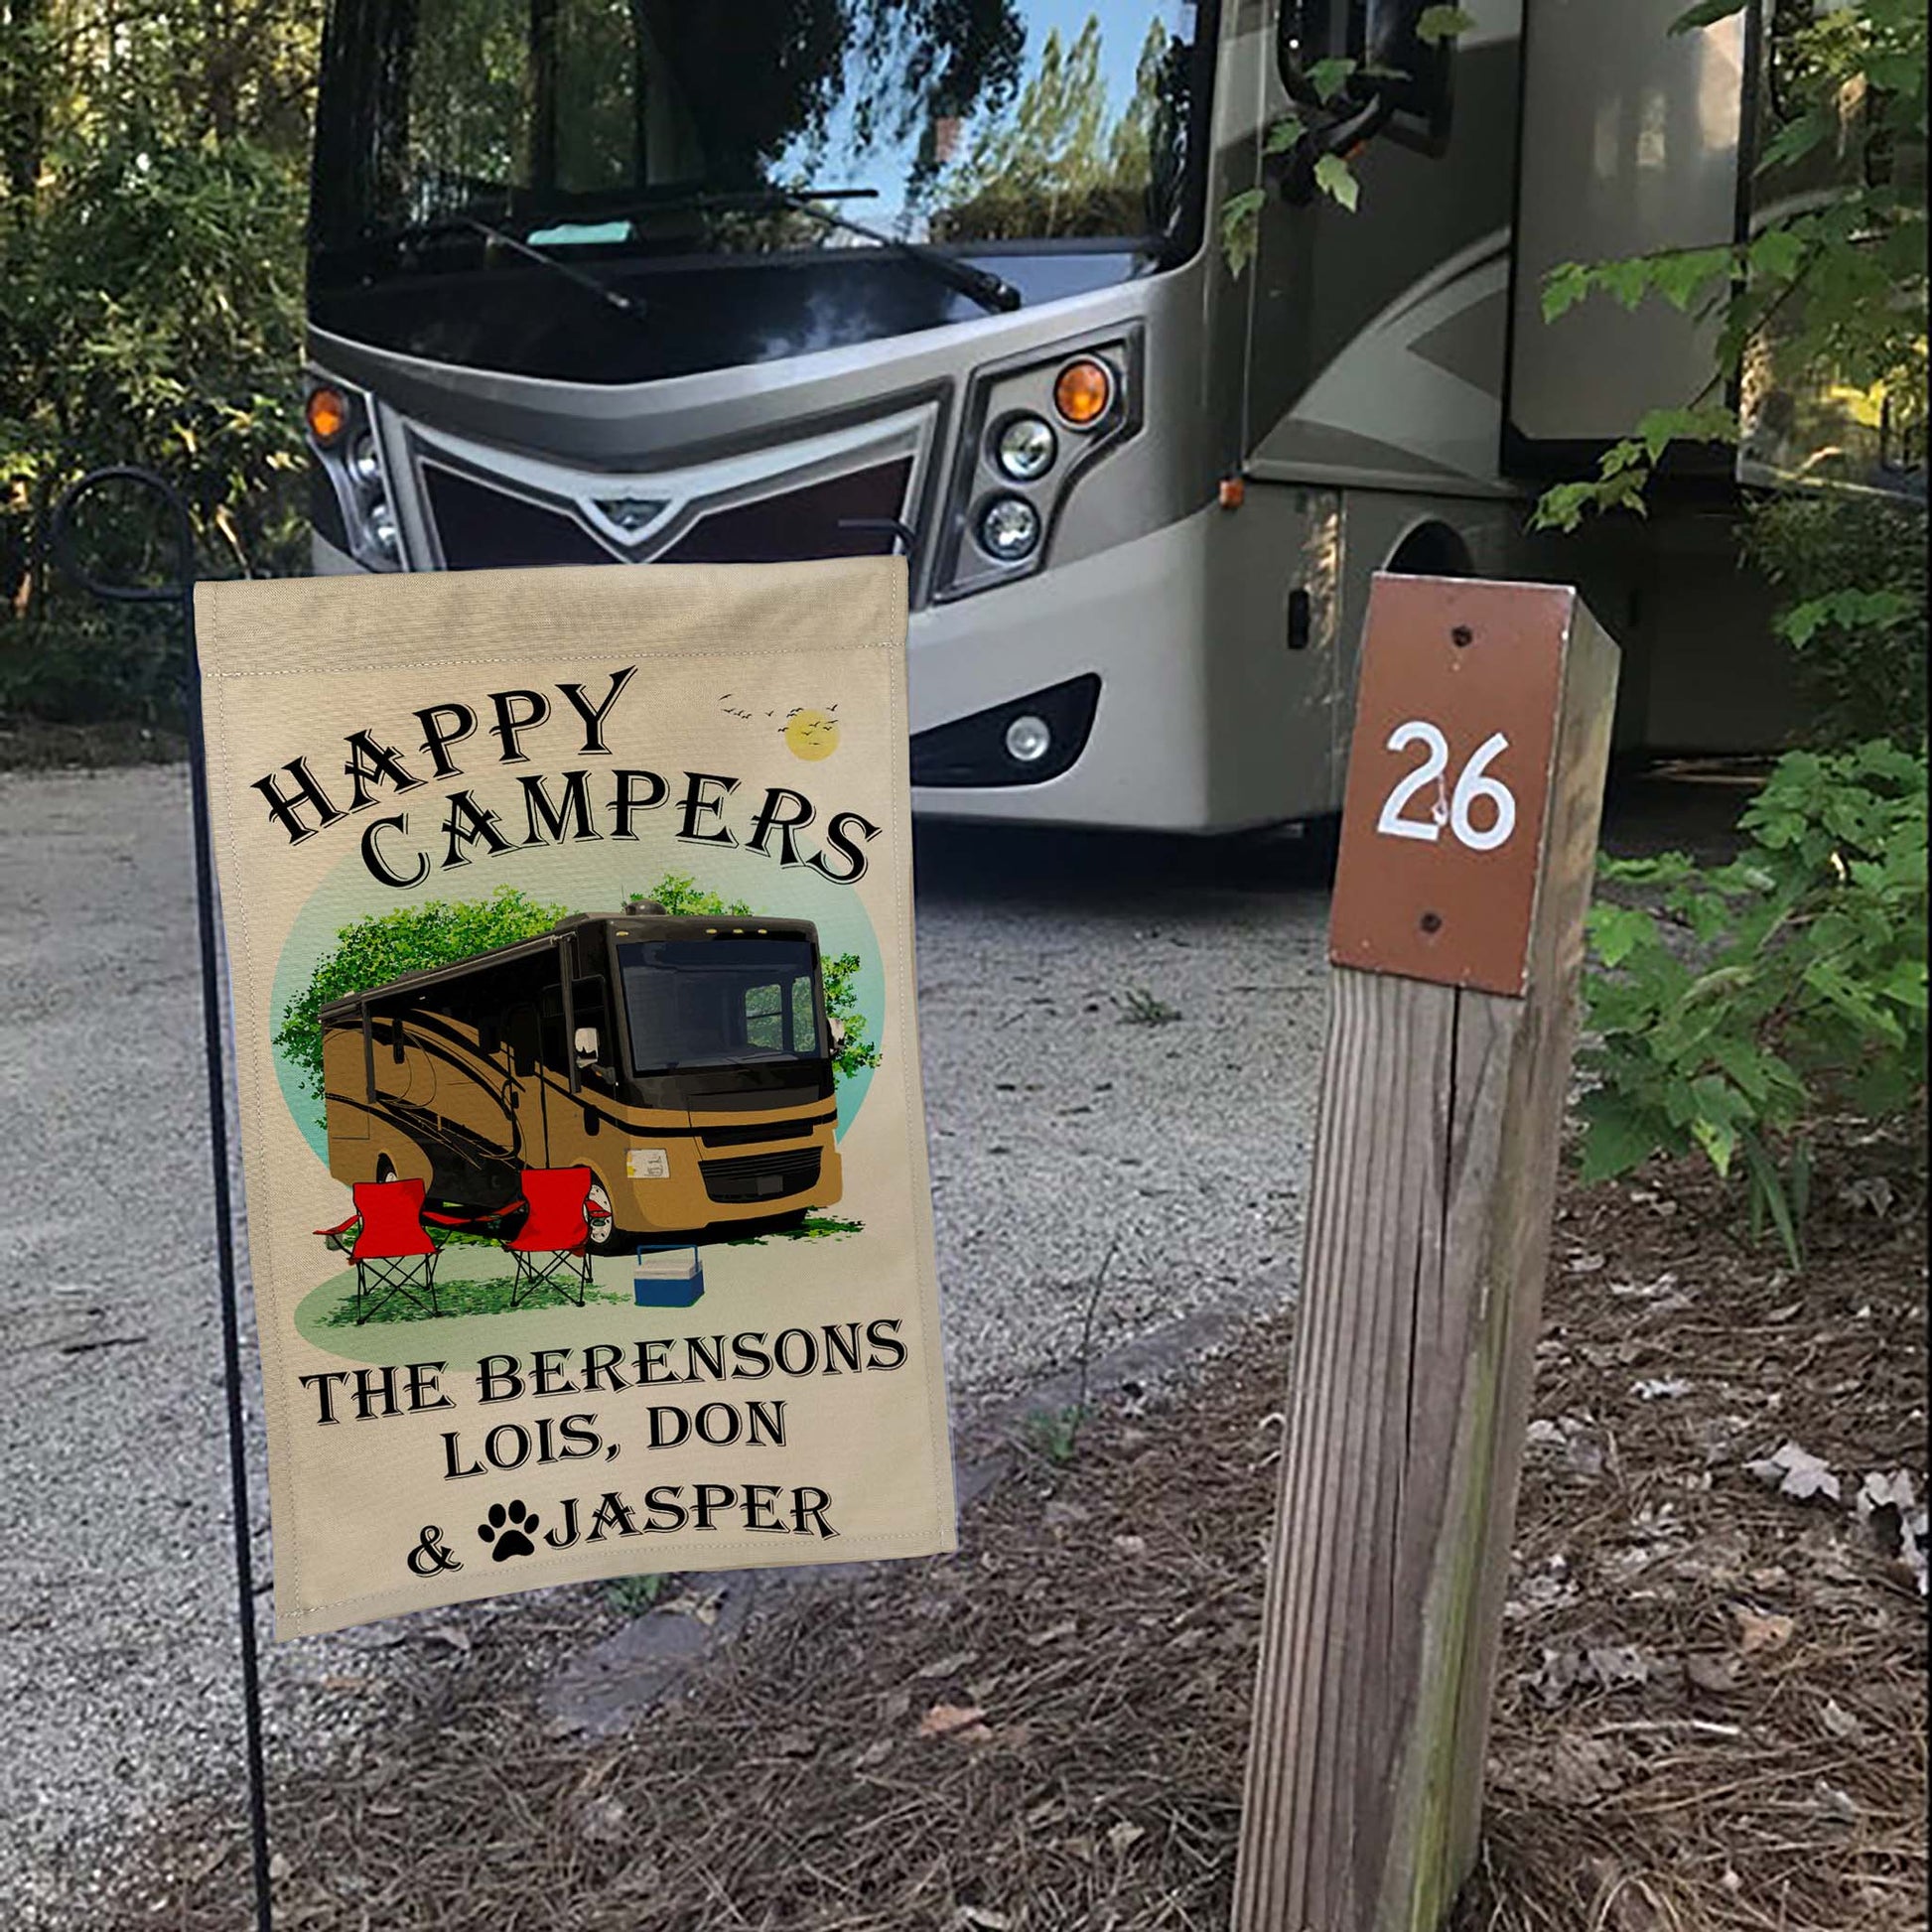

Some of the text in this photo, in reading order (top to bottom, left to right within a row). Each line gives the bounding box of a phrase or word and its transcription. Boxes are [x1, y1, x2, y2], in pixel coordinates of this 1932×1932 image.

[250, 665, 638, 847] HAPPY
[1377, 721, 1517, 851] 26
[360, 769, 883, 890] CAMPERS
[298, 1318, 908, 1427] THE BERENSONS
[442, 1400, 789, 1481] LOIS, DON
[406, 1483, 840, 1578] & JASPER
